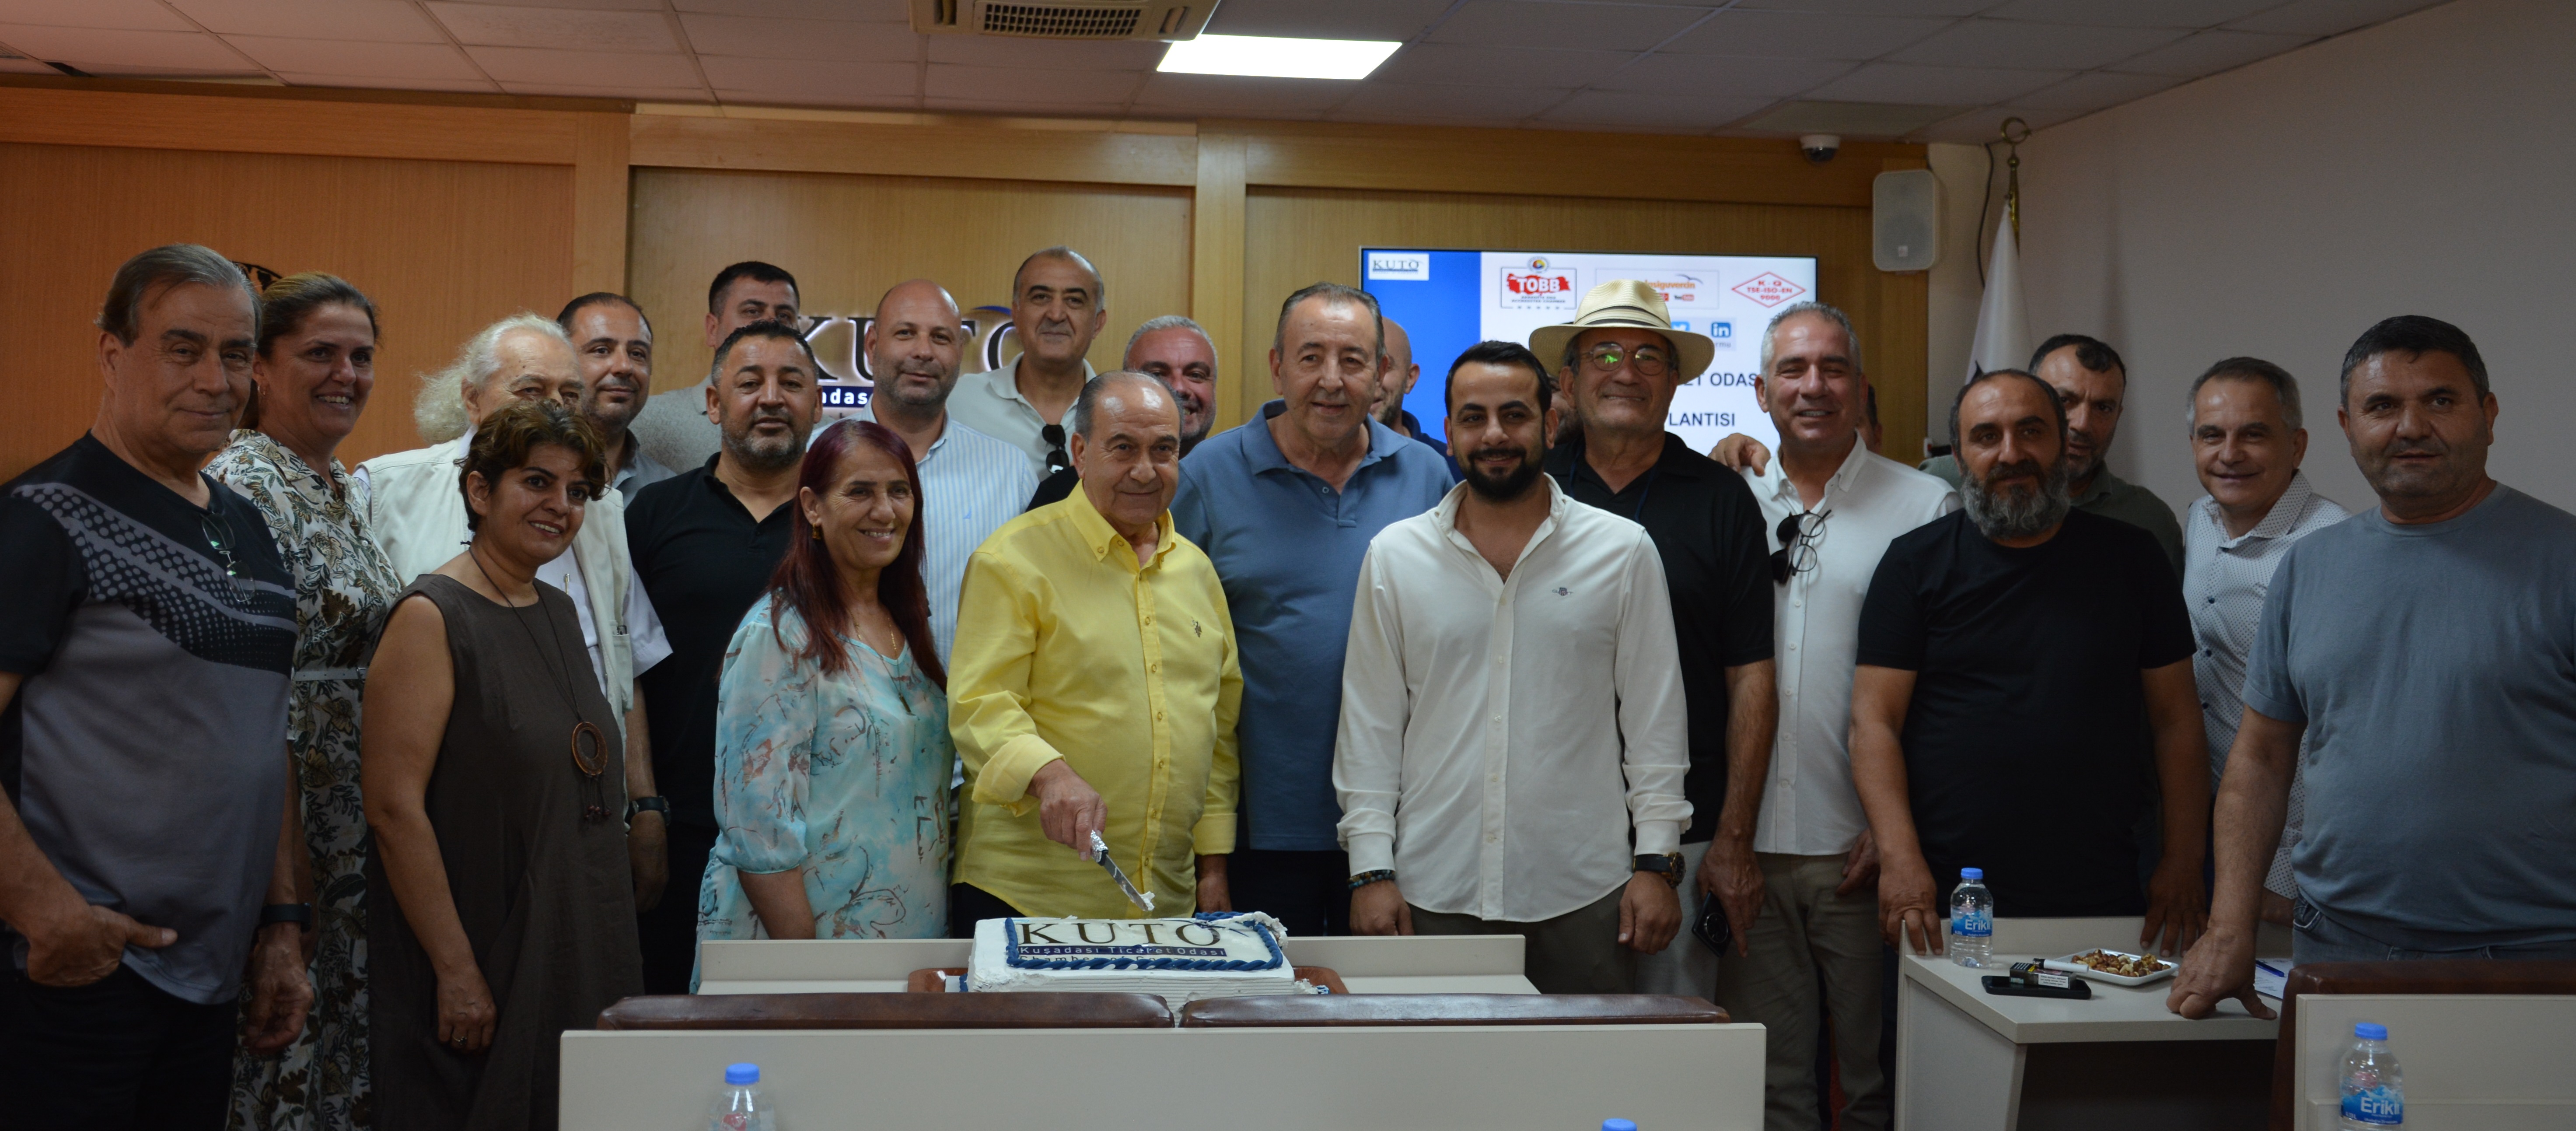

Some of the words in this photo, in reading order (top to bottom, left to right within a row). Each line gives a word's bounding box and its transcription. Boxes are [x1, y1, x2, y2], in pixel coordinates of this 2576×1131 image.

[1373, 259, 1419, 270] KUTO
[1517, 277, 1561, 292] TOBB
[1016, 923, 1220, 946] KUTO
